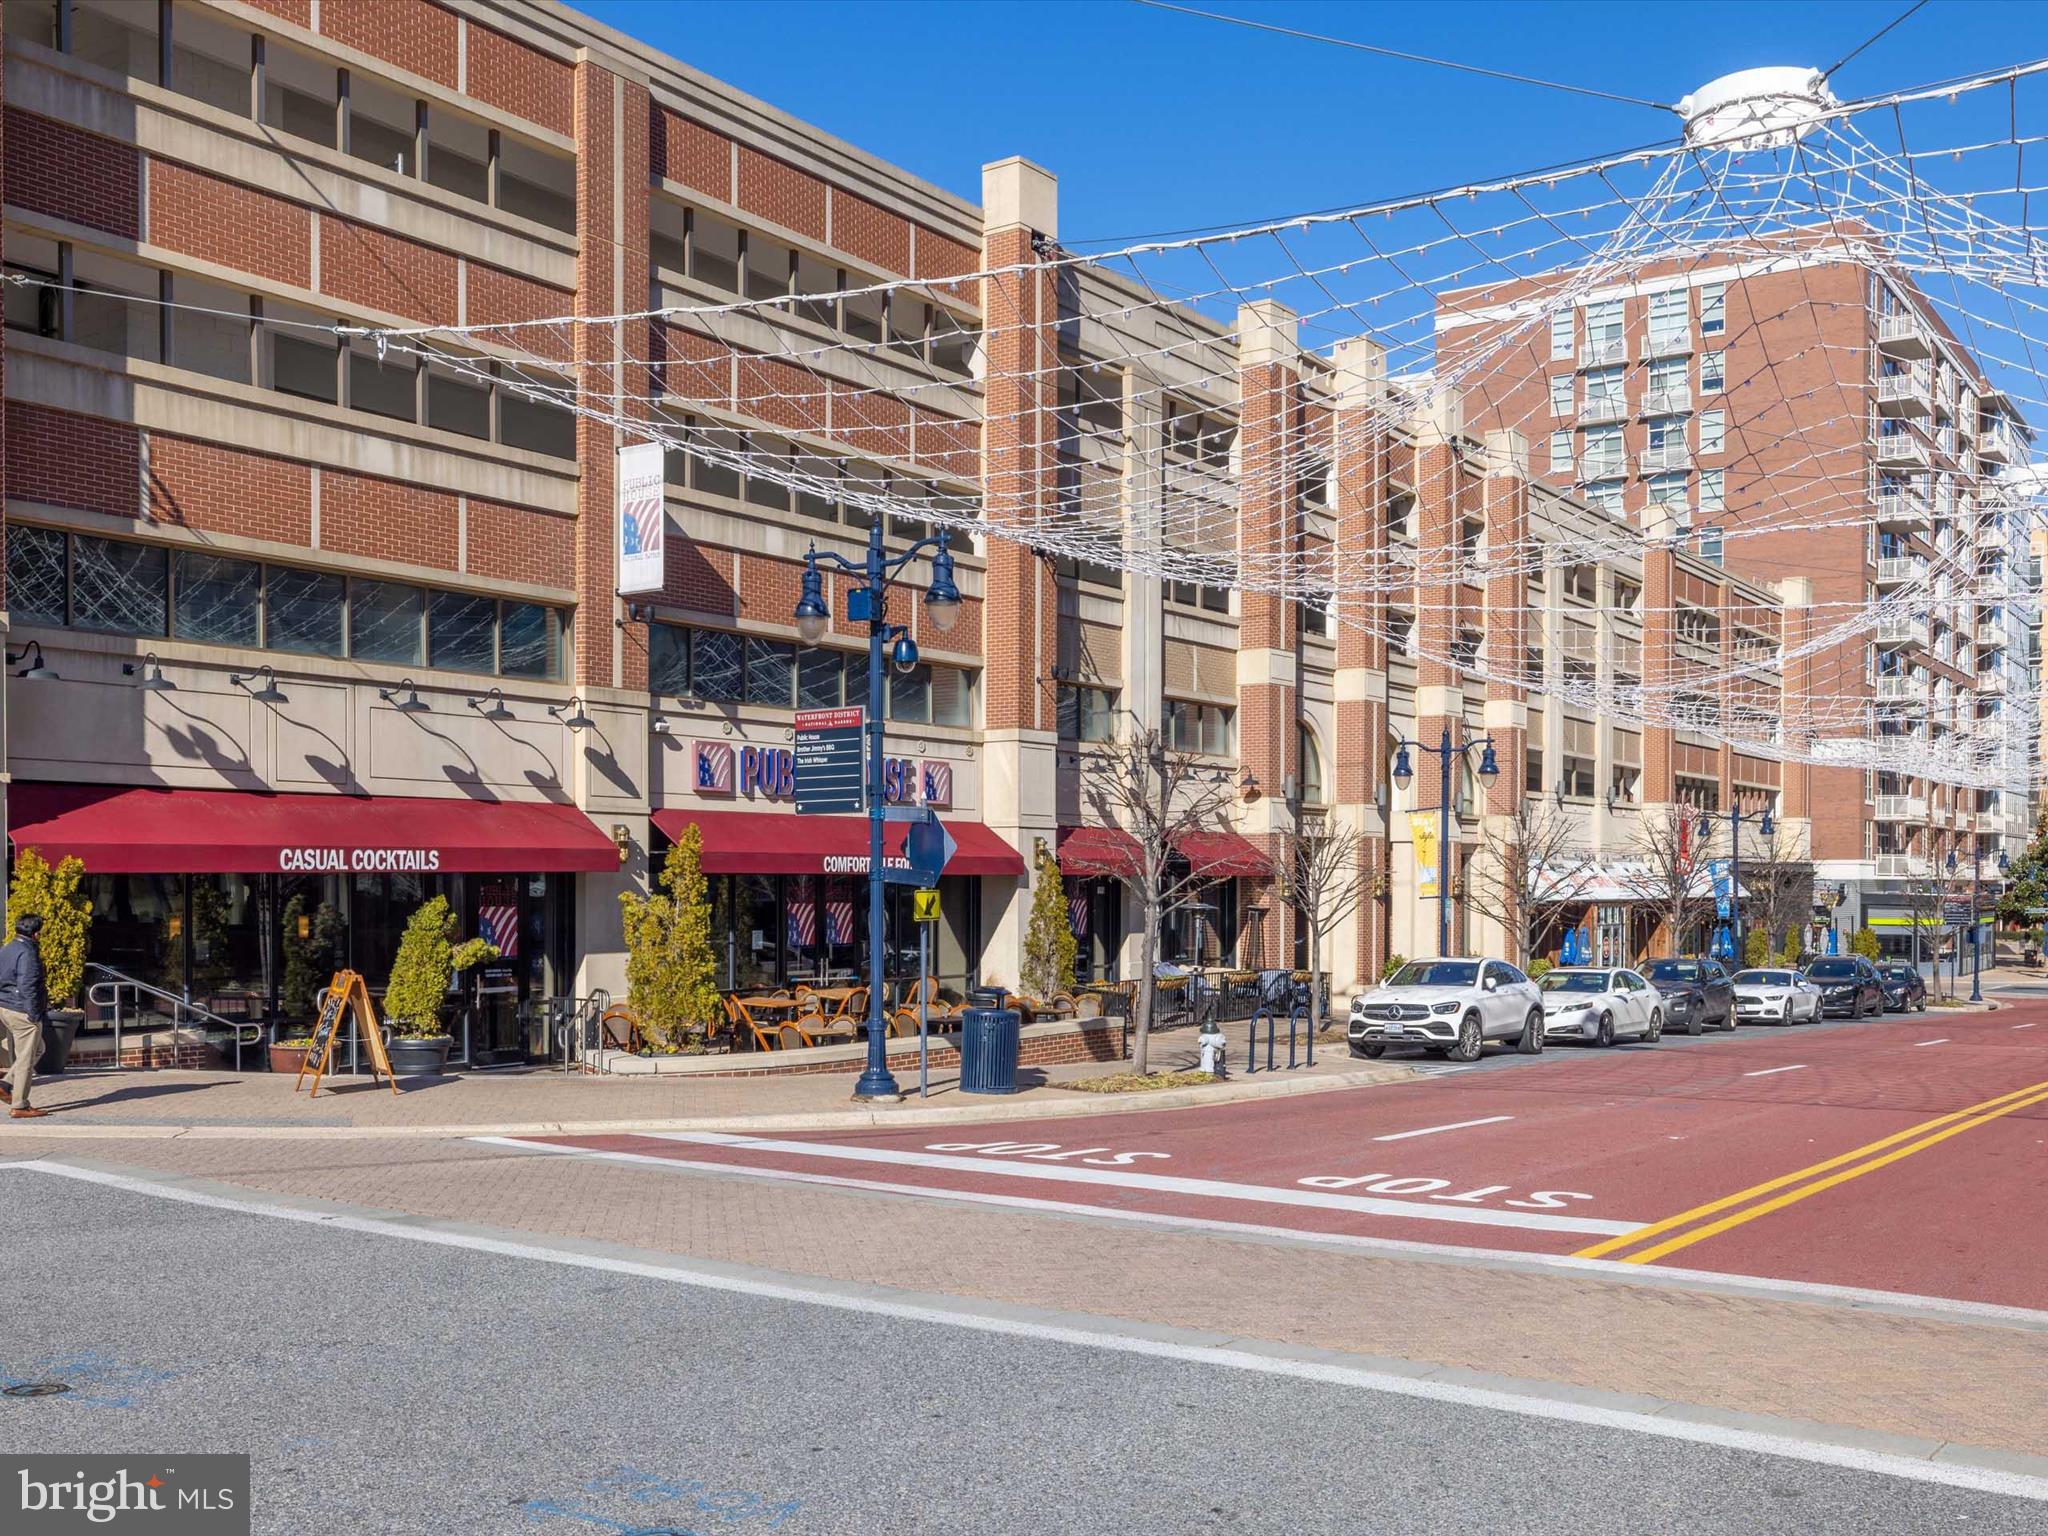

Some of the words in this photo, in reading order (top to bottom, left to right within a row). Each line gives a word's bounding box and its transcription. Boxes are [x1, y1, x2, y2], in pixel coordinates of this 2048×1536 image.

[624, 474, 660, 490] PUBLIC
[624, 486, 660, 501] HOUSE
[796, 712, 833, 721] WATERFRONT
[834, 710, 860, 718] DISTRICT
[811, 744, 825, 752] Jimmy's
[279, 849, 348, 870] CASUAL
[351, 849, 440, 870] COCKTAILS
[823, 856, 894, 873] COMFORTLE
[925, 1141, 1171, 1165] STOP
[1297, 1173, 1593, 1208] STOP
